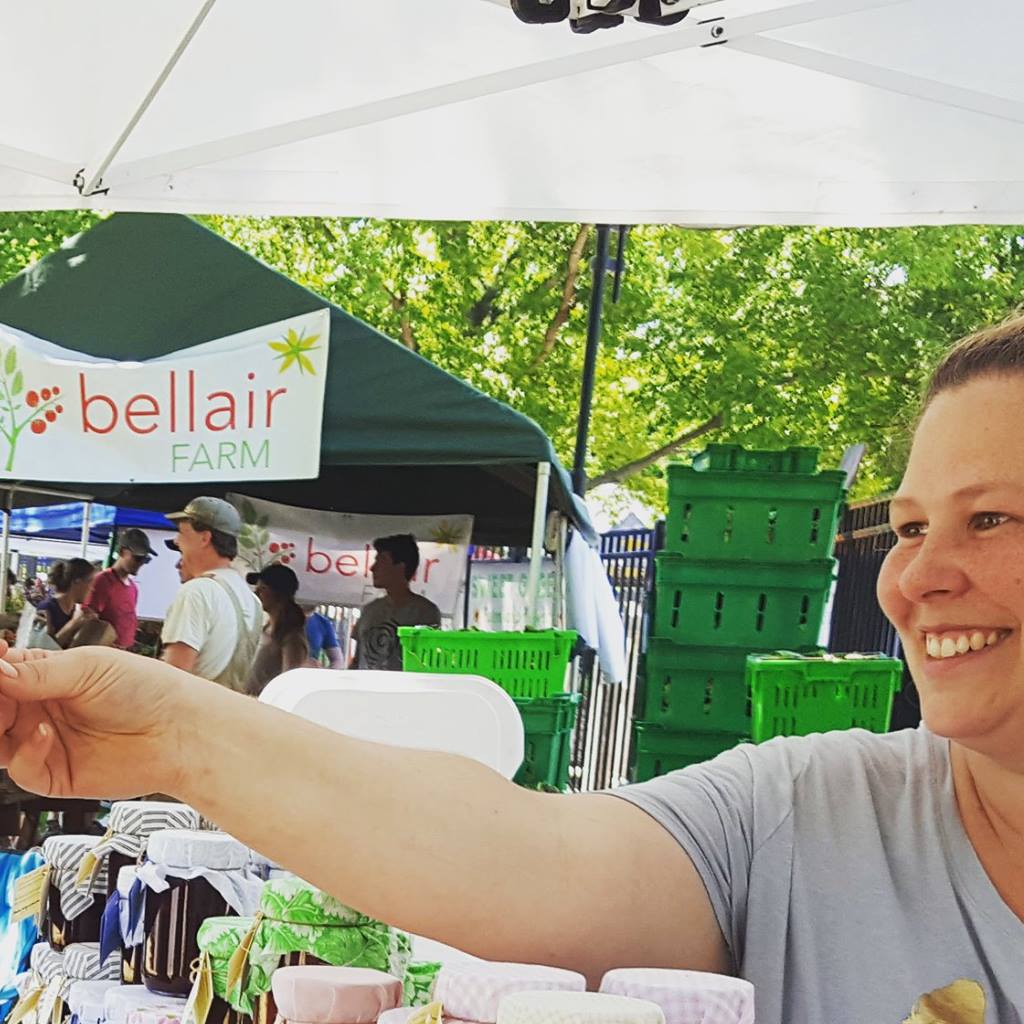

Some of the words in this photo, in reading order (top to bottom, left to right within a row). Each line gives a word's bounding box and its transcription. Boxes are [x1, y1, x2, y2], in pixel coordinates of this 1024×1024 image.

[79, 369, 287, 435] bellair
[171, 439, 270, 473] FARM
[306, 536, 440, 584] belr
